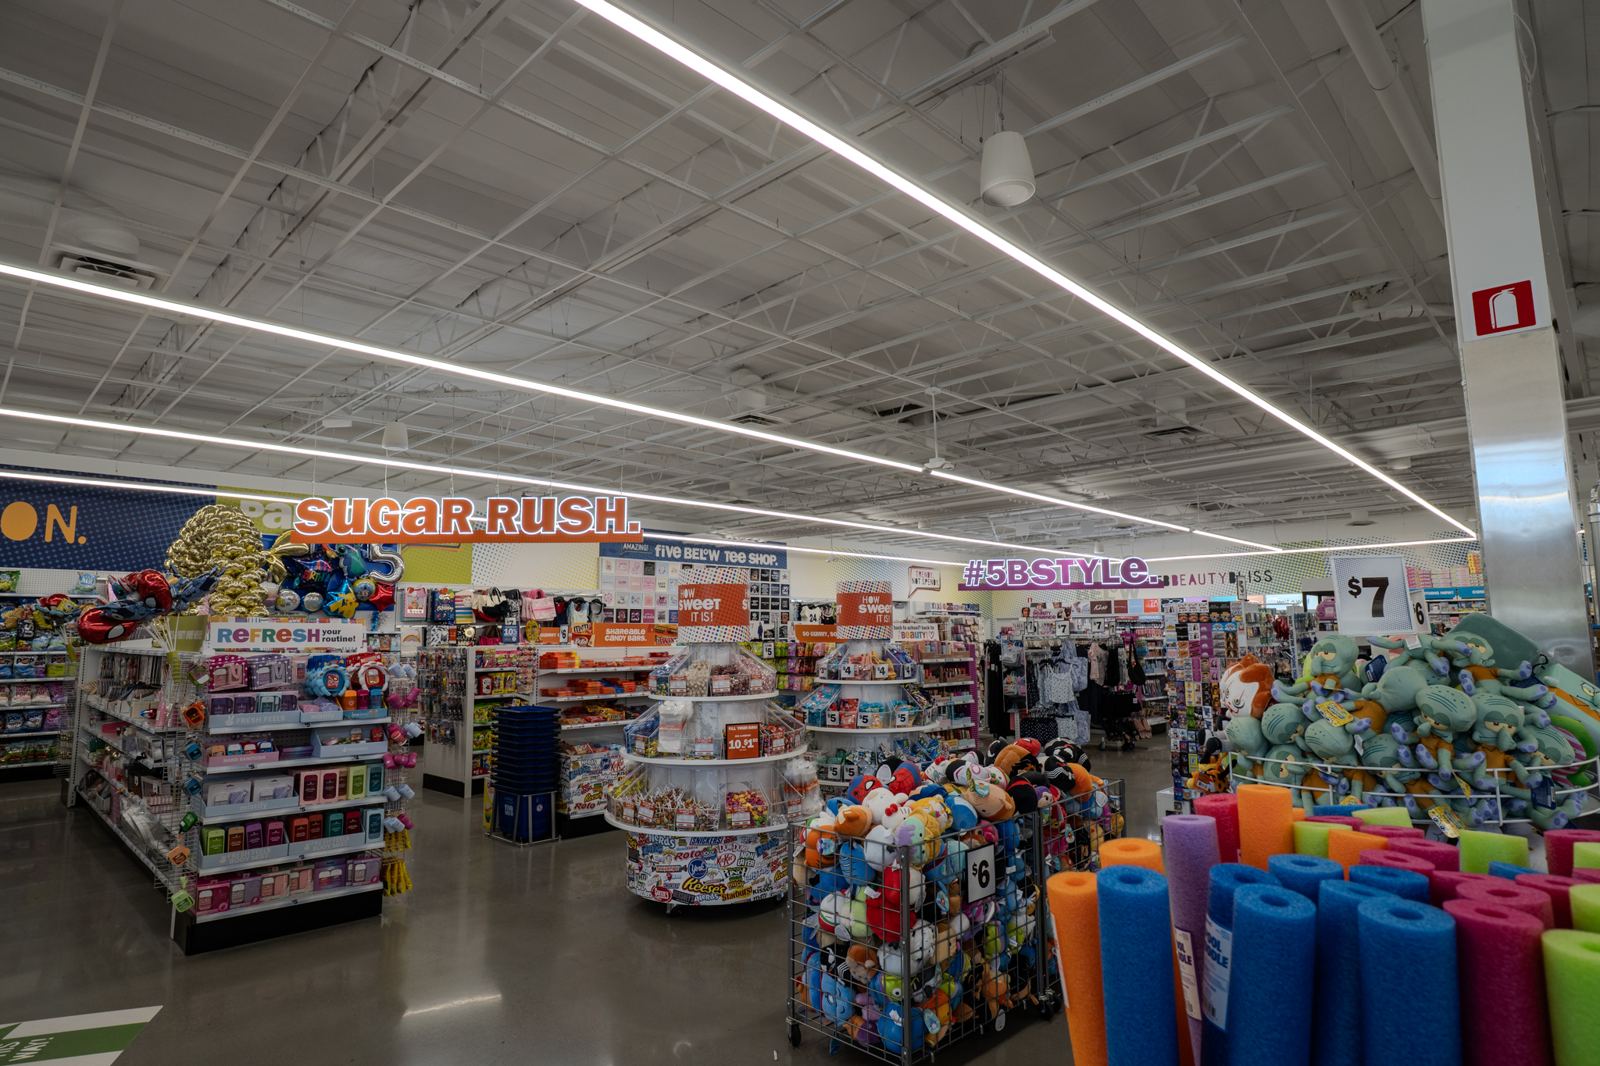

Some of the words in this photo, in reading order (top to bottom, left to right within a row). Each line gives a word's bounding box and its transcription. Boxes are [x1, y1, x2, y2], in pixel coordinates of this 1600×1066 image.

[862, 595, 880, 605] HOW
[1347, 576, 1389, 618] $7
[322, 629, 341, 638] your
[971, 859, 991, 889] $6
